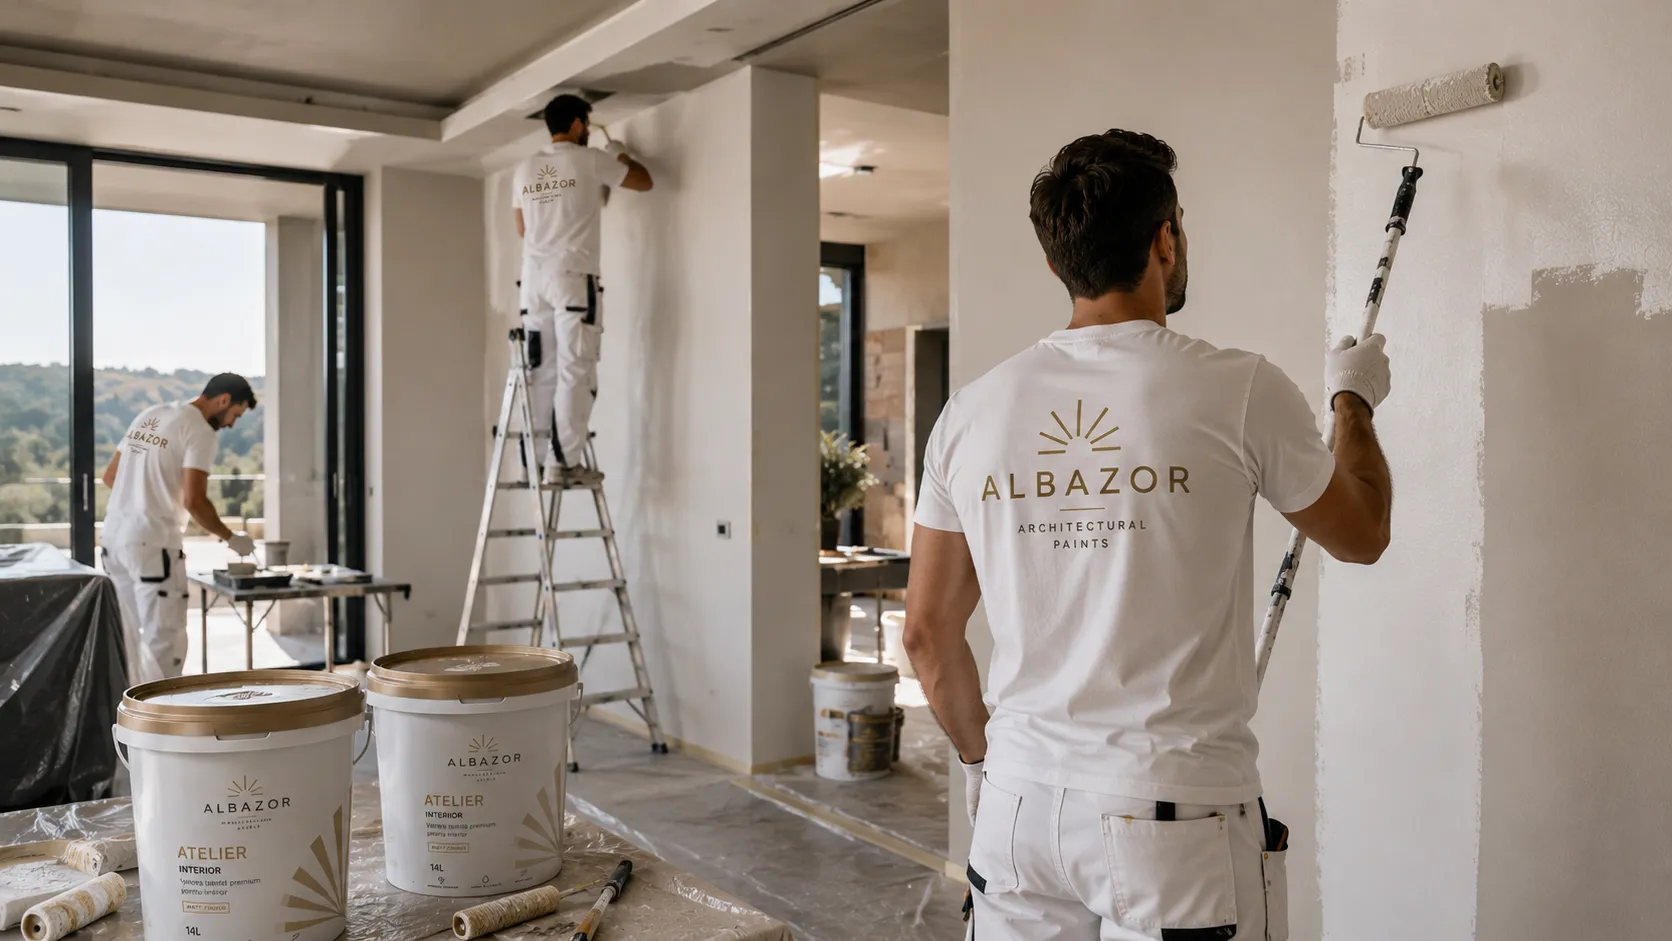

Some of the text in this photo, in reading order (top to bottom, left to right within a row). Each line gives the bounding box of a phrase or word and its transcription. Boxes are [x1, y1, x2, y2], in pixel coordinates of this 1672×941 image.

[522, 179, 576, 195] ALBAZOR
[981, 465, 1190, 502] ALBAZOR
[1017, 520, 1147, 534] ARCHITECTURAL
[1053, 538, 1109, 550] PAINTS
[447, 753, 522, 767] ALBAZOR
[203, 797, 291, 814] ALBAZOR
[424, 794, 485, 807] ATELIER
[177, 846, 248, 860] ATELIER
[178, 865, 222, 875] INTERIOR
[430, 863, 444, 872] 14L
[229, 878, 261, 887] premium
[185, 926, 201, 936] 14L
